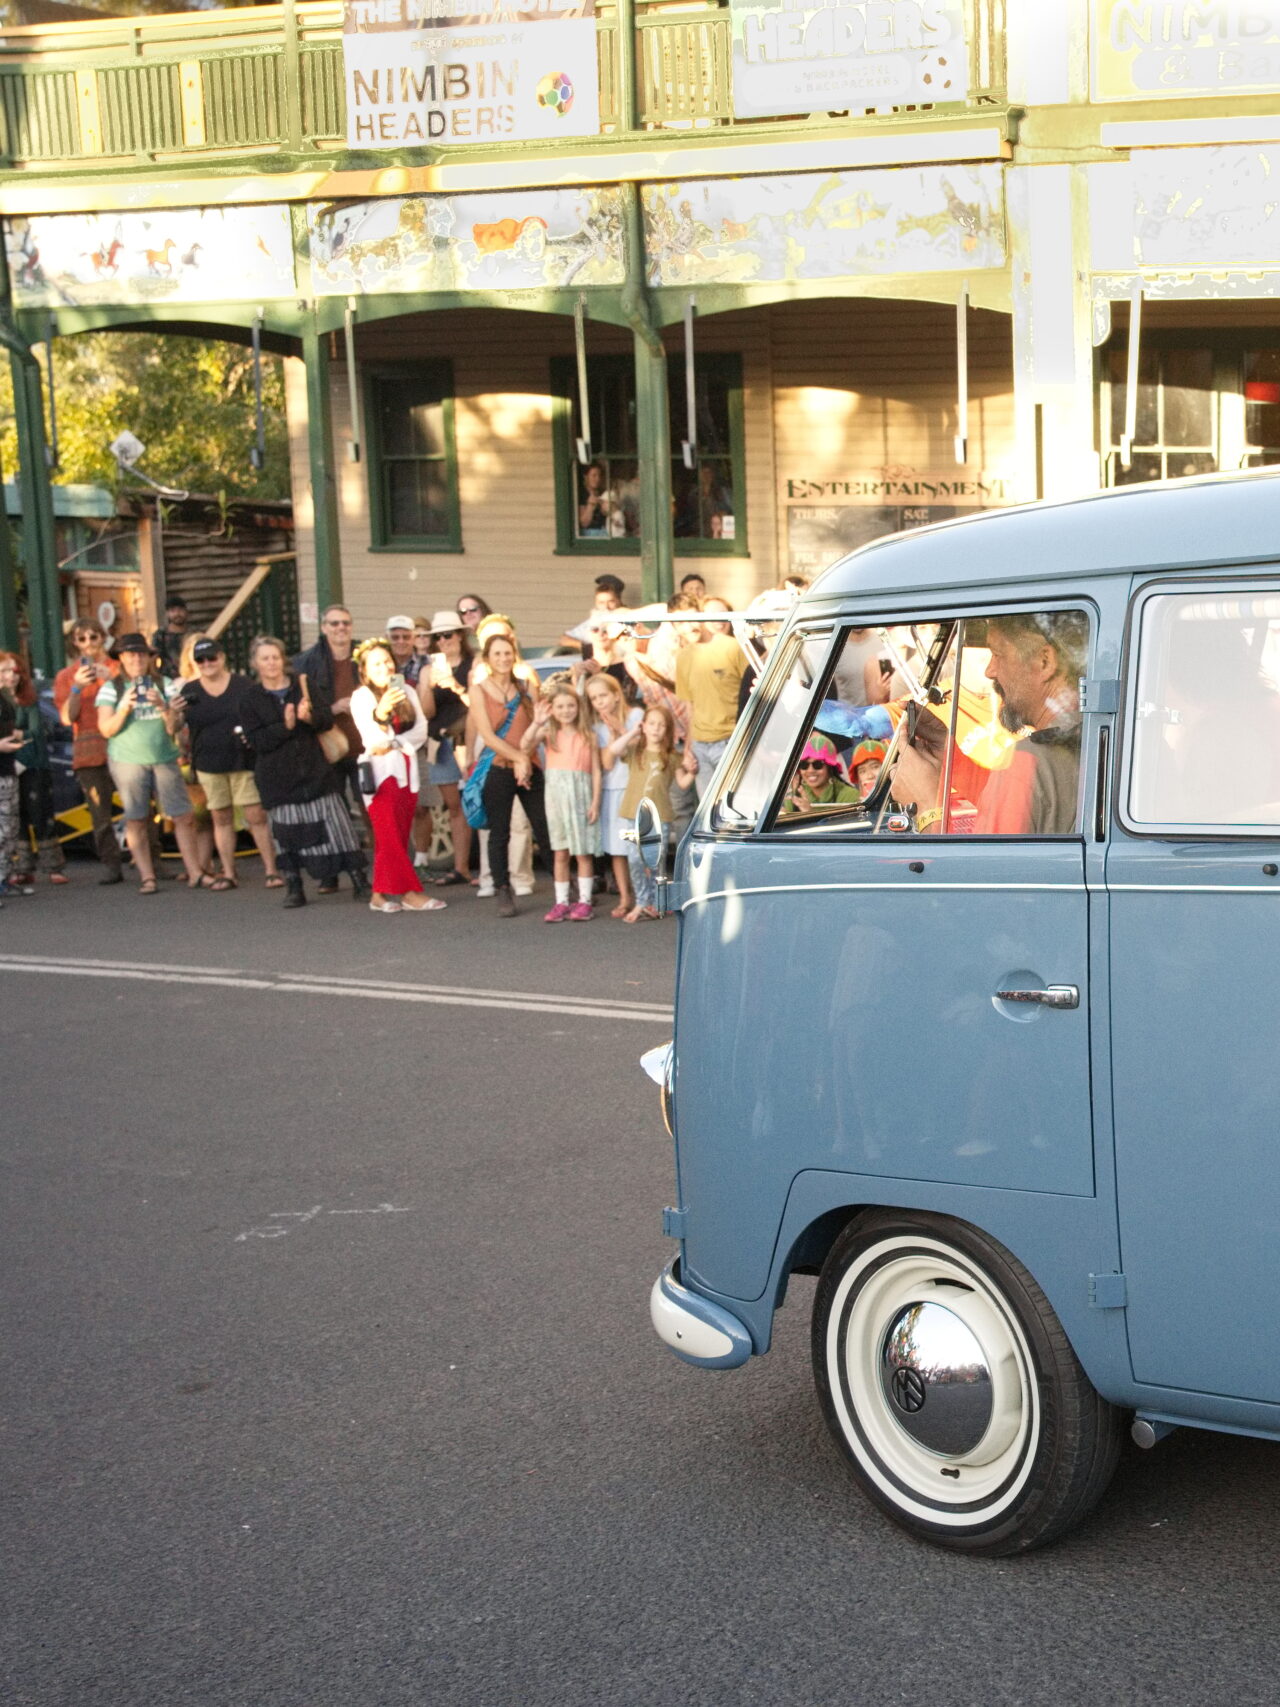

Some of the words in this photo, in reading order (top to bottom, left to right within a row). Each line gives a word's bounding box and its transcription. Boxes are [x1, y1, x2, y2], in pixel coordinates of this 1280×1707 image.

[744, 0, 952, 64] HEADERS
[352, 58, 519, 106] NIMBIN
[355, 104, 517, 142] HEADERS
